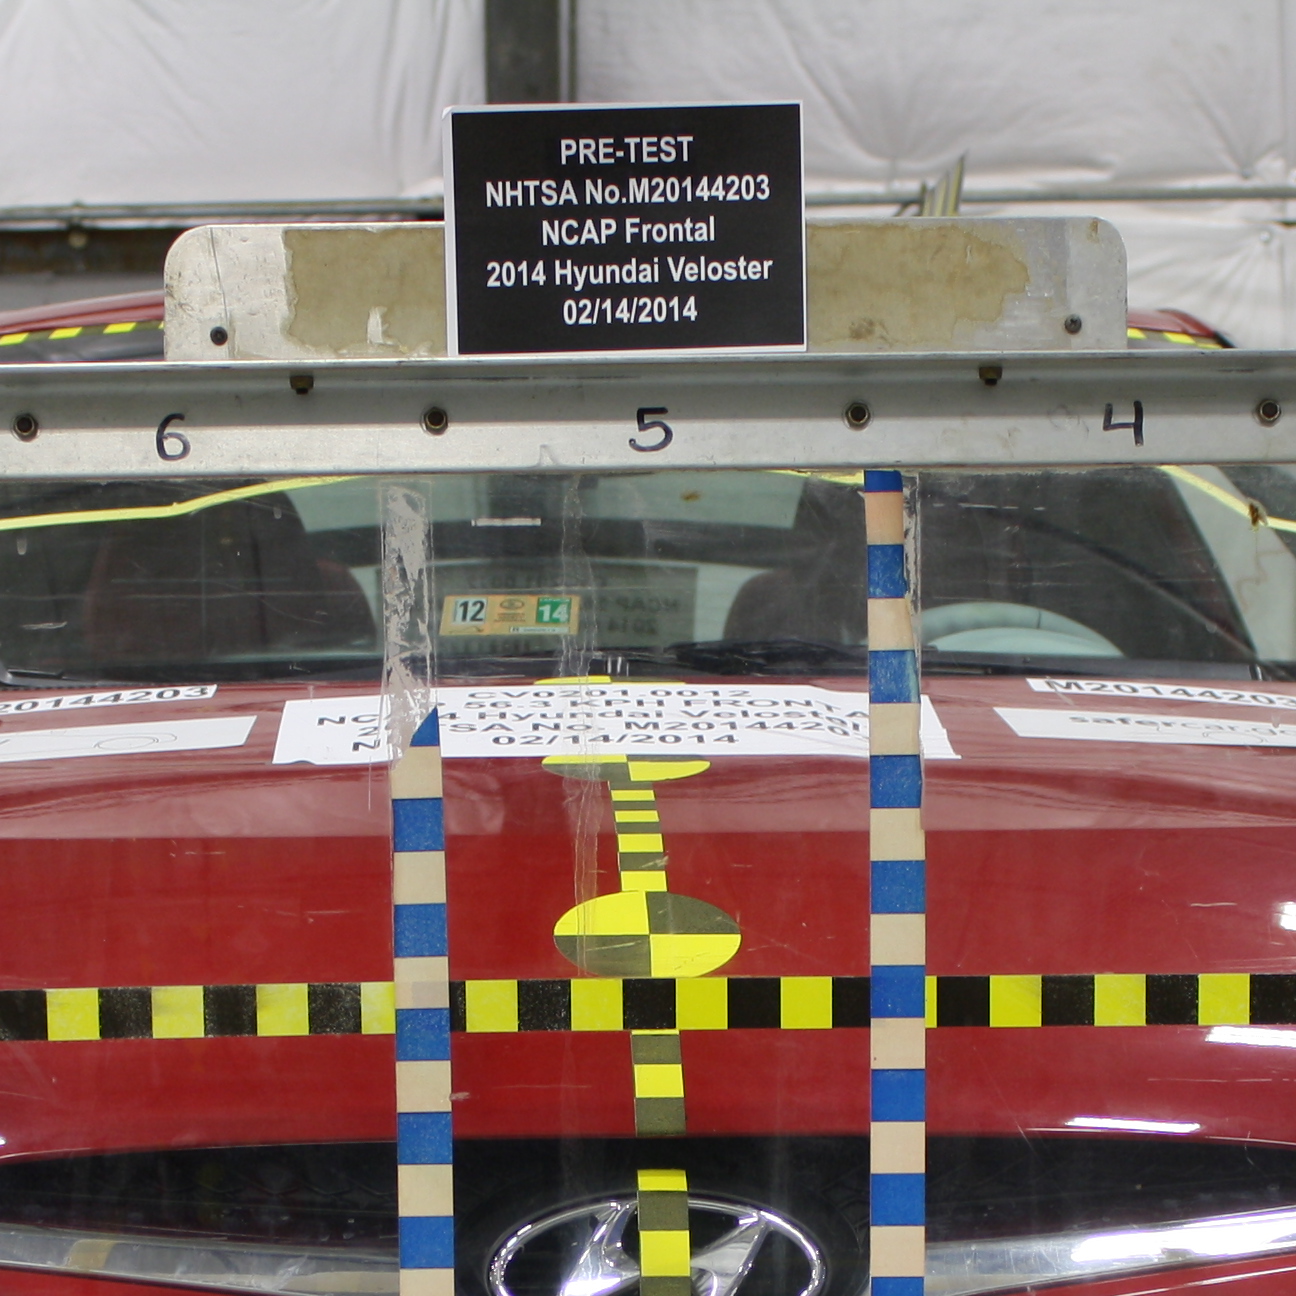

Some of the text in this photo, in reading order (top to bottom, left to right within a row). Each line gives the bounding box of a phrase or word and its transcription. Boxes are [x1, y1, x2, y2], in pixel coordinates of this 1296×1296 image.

[560, 136, 693, 165] PRE-TEST
[485, 174, 771, 207] NHTSA No.M20144203
[542, 215, 715, 246] NCAP Frontal
[486, 255, 773, 291] 2014 Hyundai Veloster
[563, 296, 698, 325] 02/14/2014
[155, 413, 191, 460] 6
[628, 407, 673, 452] 5
[1103, 400, 1144, 446] 4
[459, 599, 485, 623] 12
[539, 603, 568, 623] 14
[462, 700, 553, 710] 56.3
[569, 698, 666, 709] KPH
[467, 689, 752, 700] CV0201.0012
[478, 709, 665, 722] Hyundai
[532, 721, 606, 732] No.
[491, 733, 740, 746] 02/14/2014
